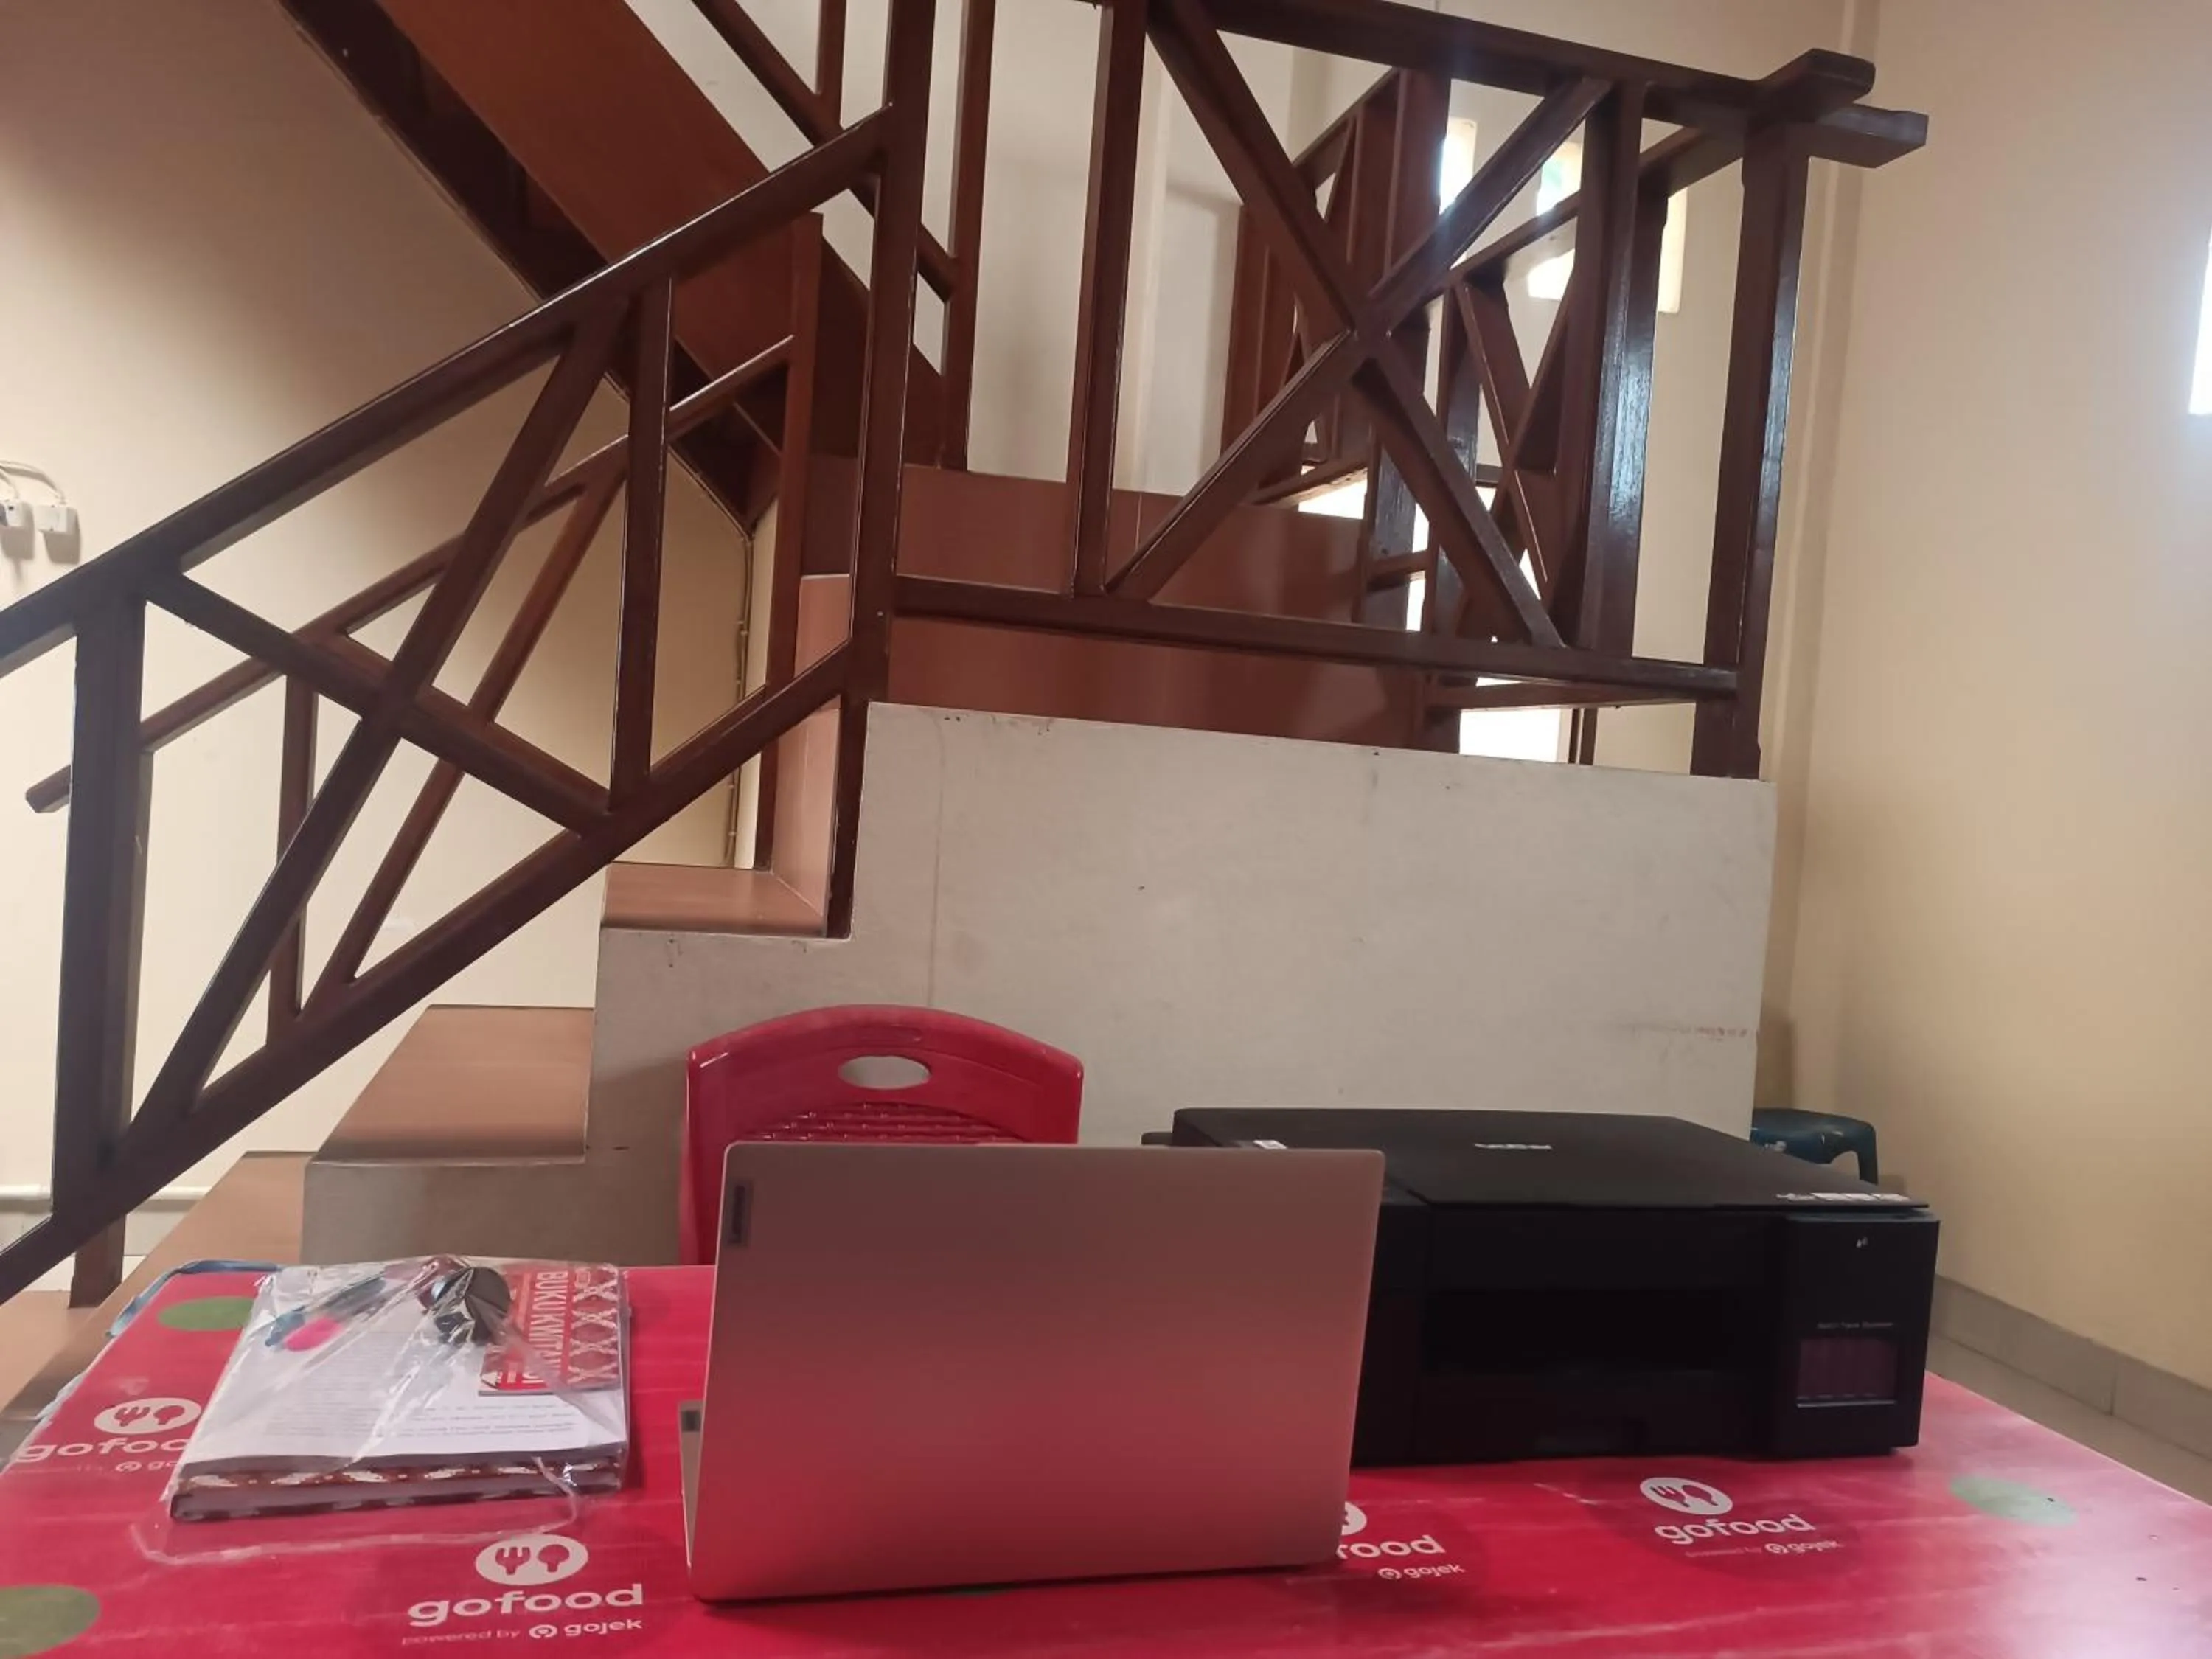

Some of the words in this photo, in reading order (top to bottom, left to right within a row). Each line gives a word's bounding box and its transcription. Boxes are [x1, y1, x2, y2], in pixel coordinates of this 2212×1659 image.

[532, 1270, 569, 1310] BUKU
[15, 1437, 191, 1463] gofoo
[1654, 1514, 1816, 1545] gofood
[1403, 1563, 1466, 1579] gojek
[407, 1583, 644, 1627] gofood
[402, 1630, 492, 1646] powered
[496, 1629, 521, 1640] by
[563, 1619, 643, 1637] gojek
